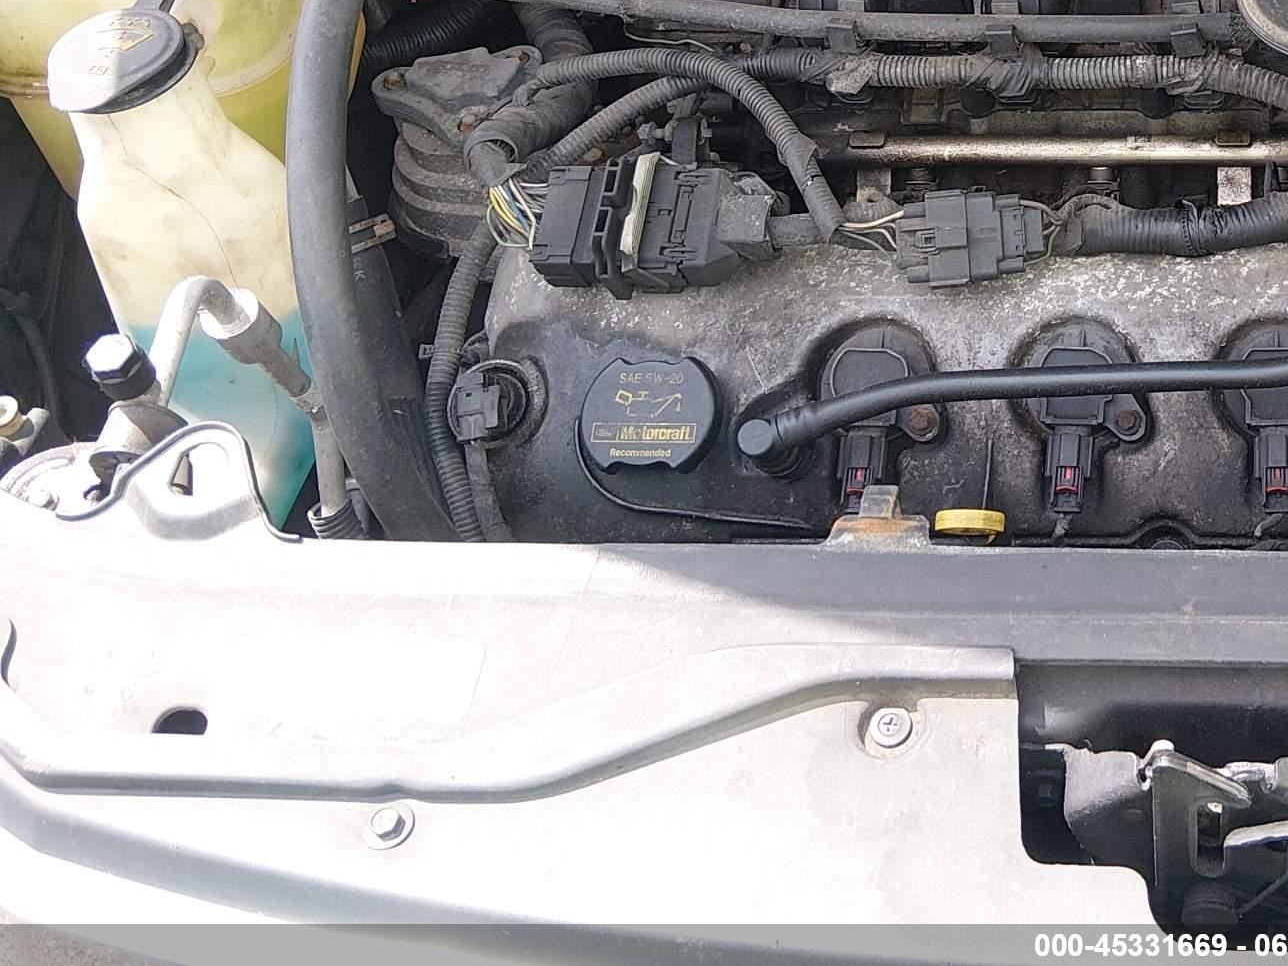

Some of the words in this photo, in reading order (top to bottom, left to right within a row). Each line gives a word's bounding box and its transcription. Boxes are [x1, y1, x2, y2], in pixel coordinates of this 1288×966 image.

[619, 372, 642, 384] SAE
[645, 372, 684, 385] 5W-20
[620, 425, 691, 440] Motorcraft
[609, 448, 671, 457] Recommended
